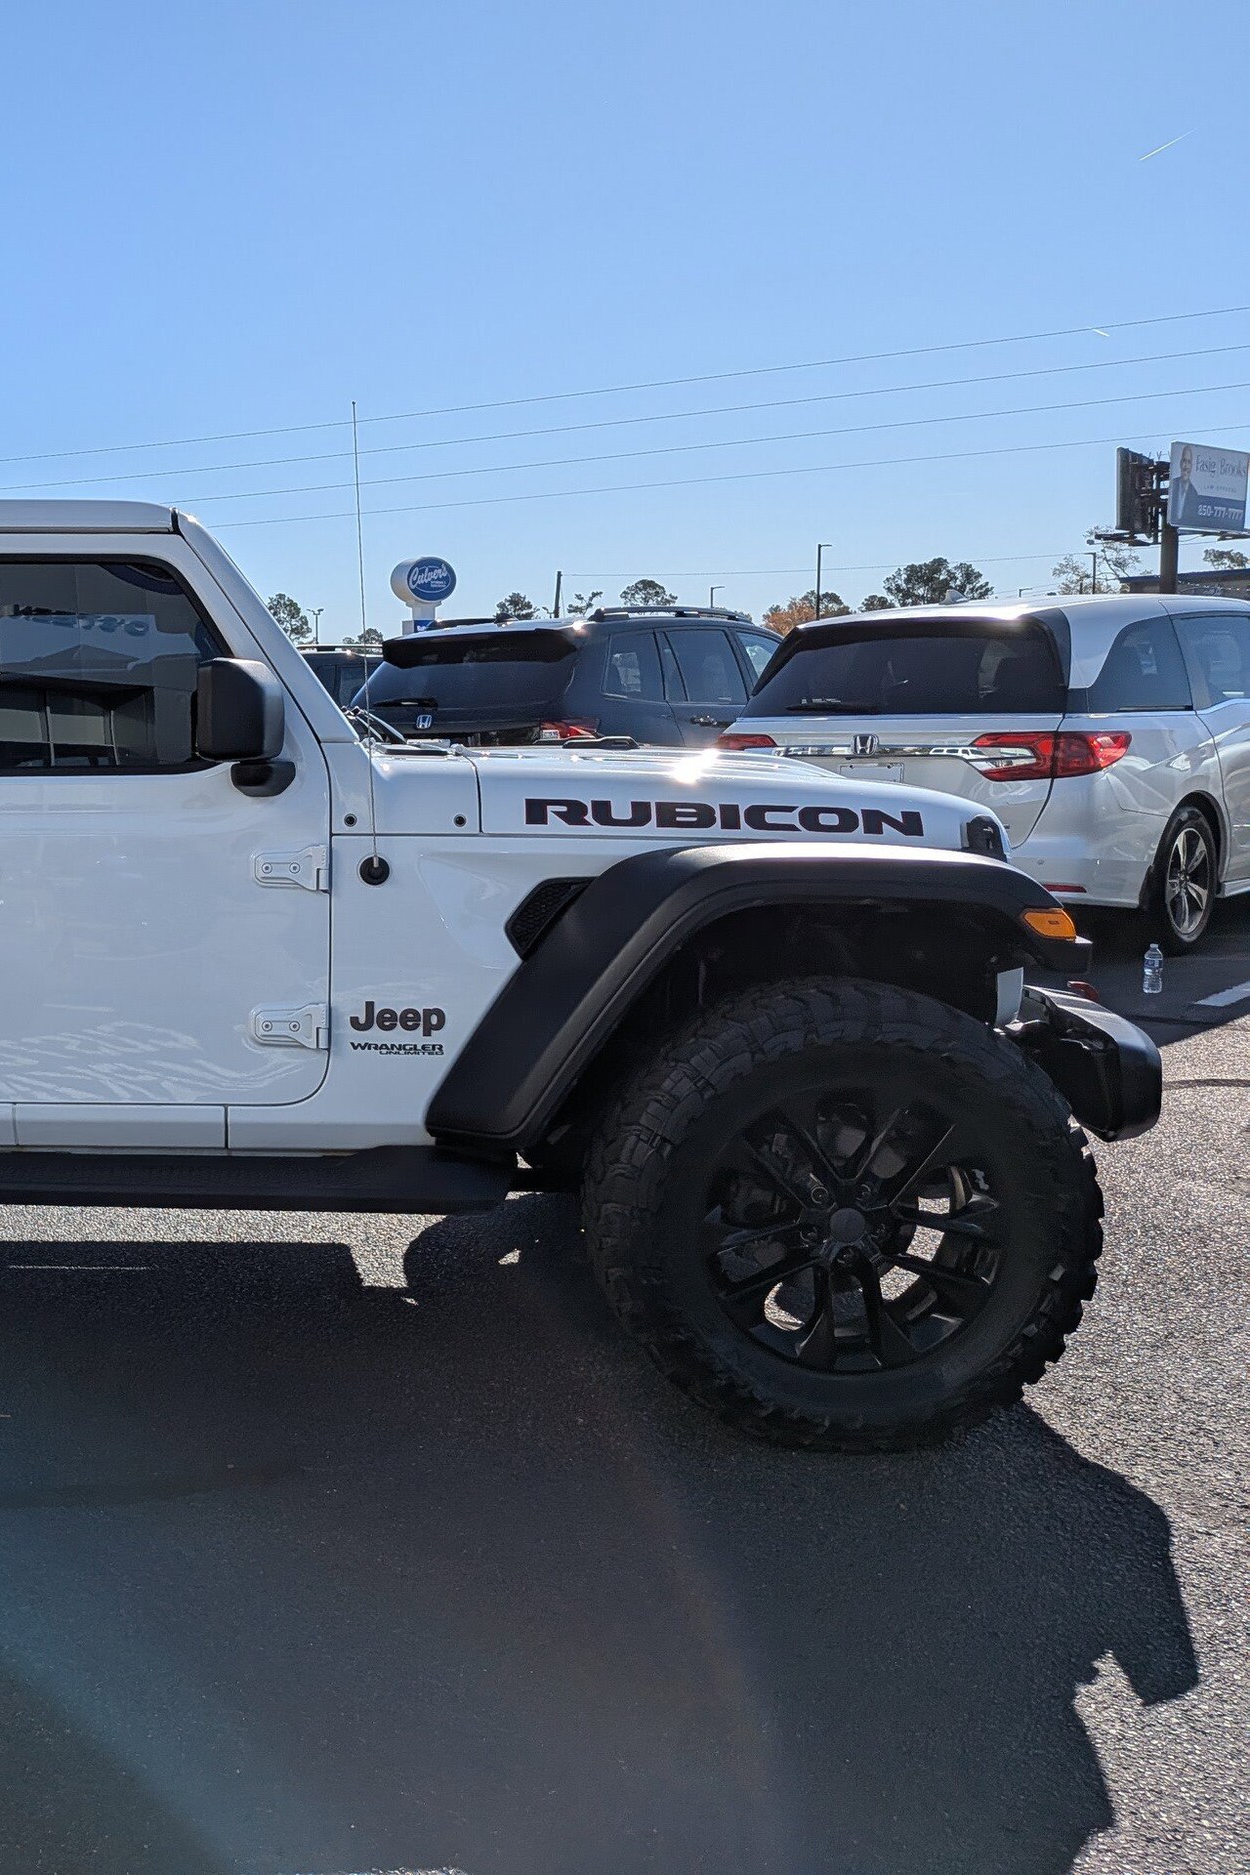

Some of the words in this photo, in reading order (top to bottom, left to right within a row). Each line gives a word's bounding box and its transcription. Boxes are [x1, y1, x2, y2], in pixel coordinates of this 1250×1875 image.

[1198, 504, 1244, 519] 850-777-7777
[524, 798, 925, 837] RUBICON
[350, 1001, 446, 1037] Jeep
[350, 1042, 444, 1052] WRANGLER
